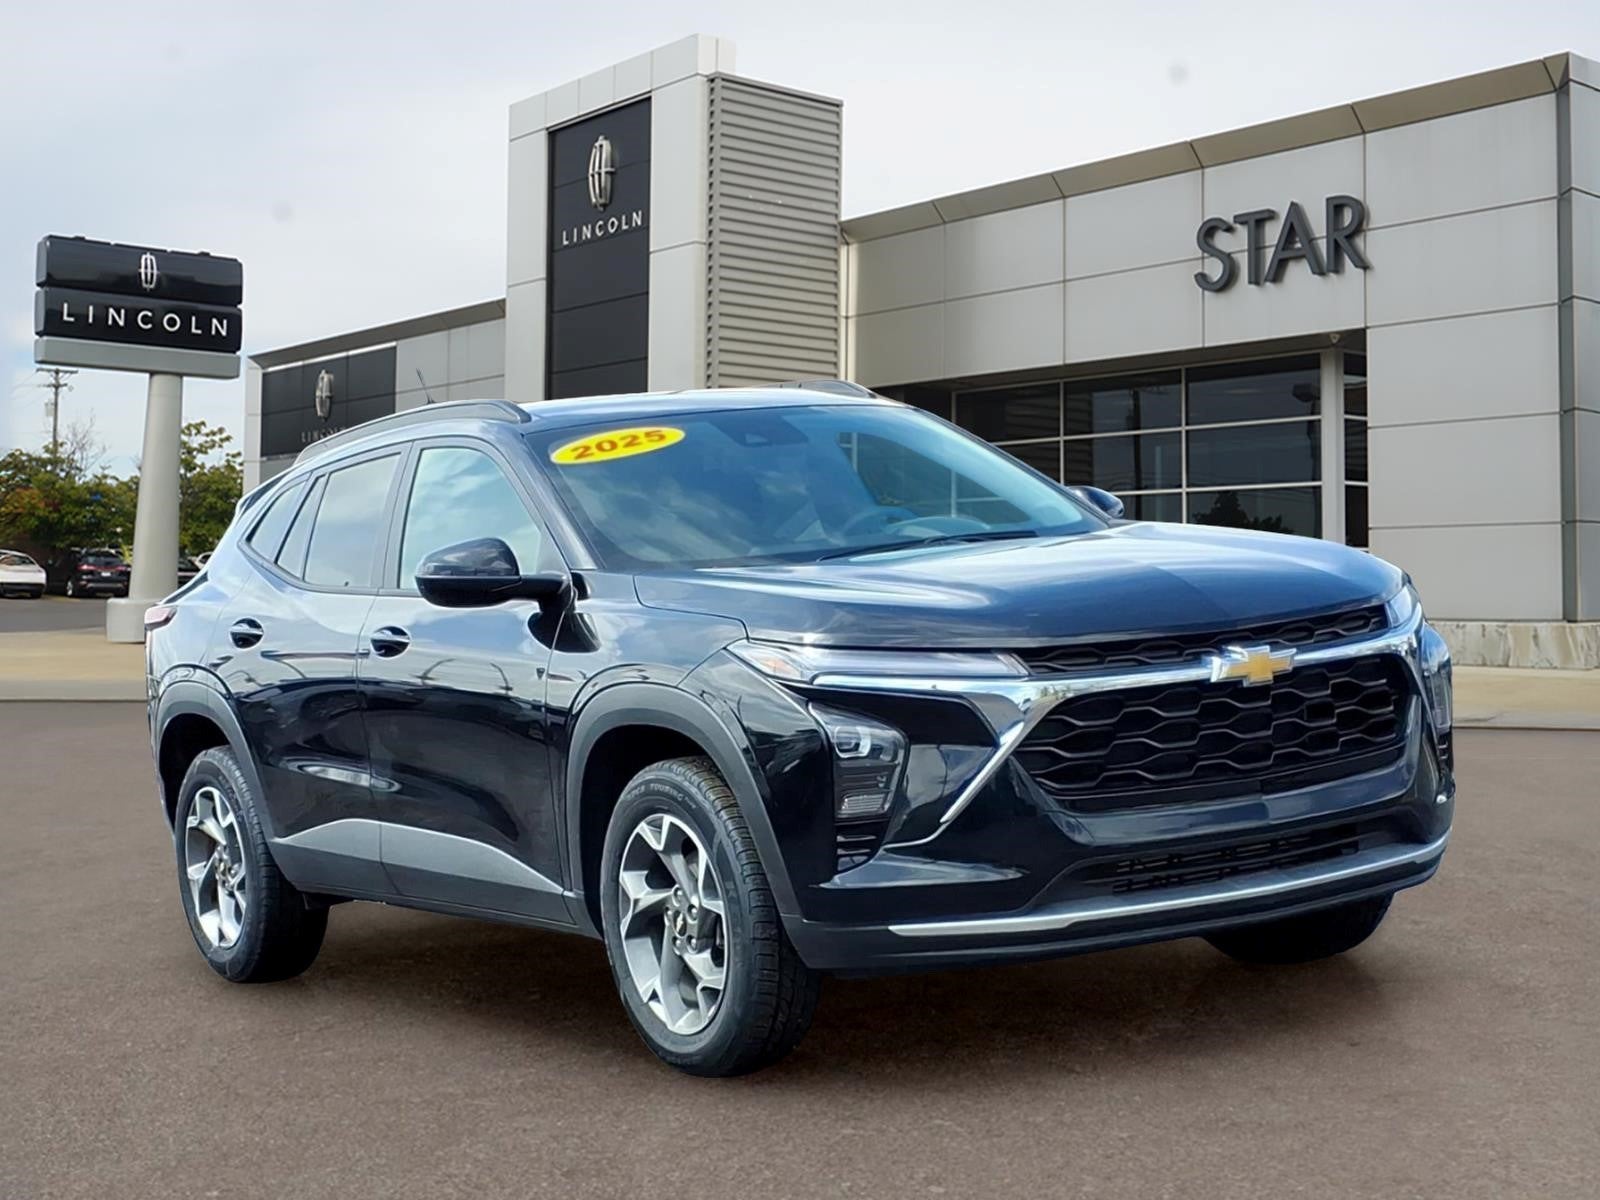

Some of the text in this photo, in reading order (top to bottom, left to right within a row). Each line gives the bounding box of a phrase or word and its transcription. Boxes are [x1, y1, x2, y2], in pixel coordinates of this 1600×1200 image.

[562, 210, 643, 245] LINCOLN
[1194, 195, 1371, 292] STAR
[62, 302, 227, 337] LINCOLN
[571, 430, 667, 460] 2025
